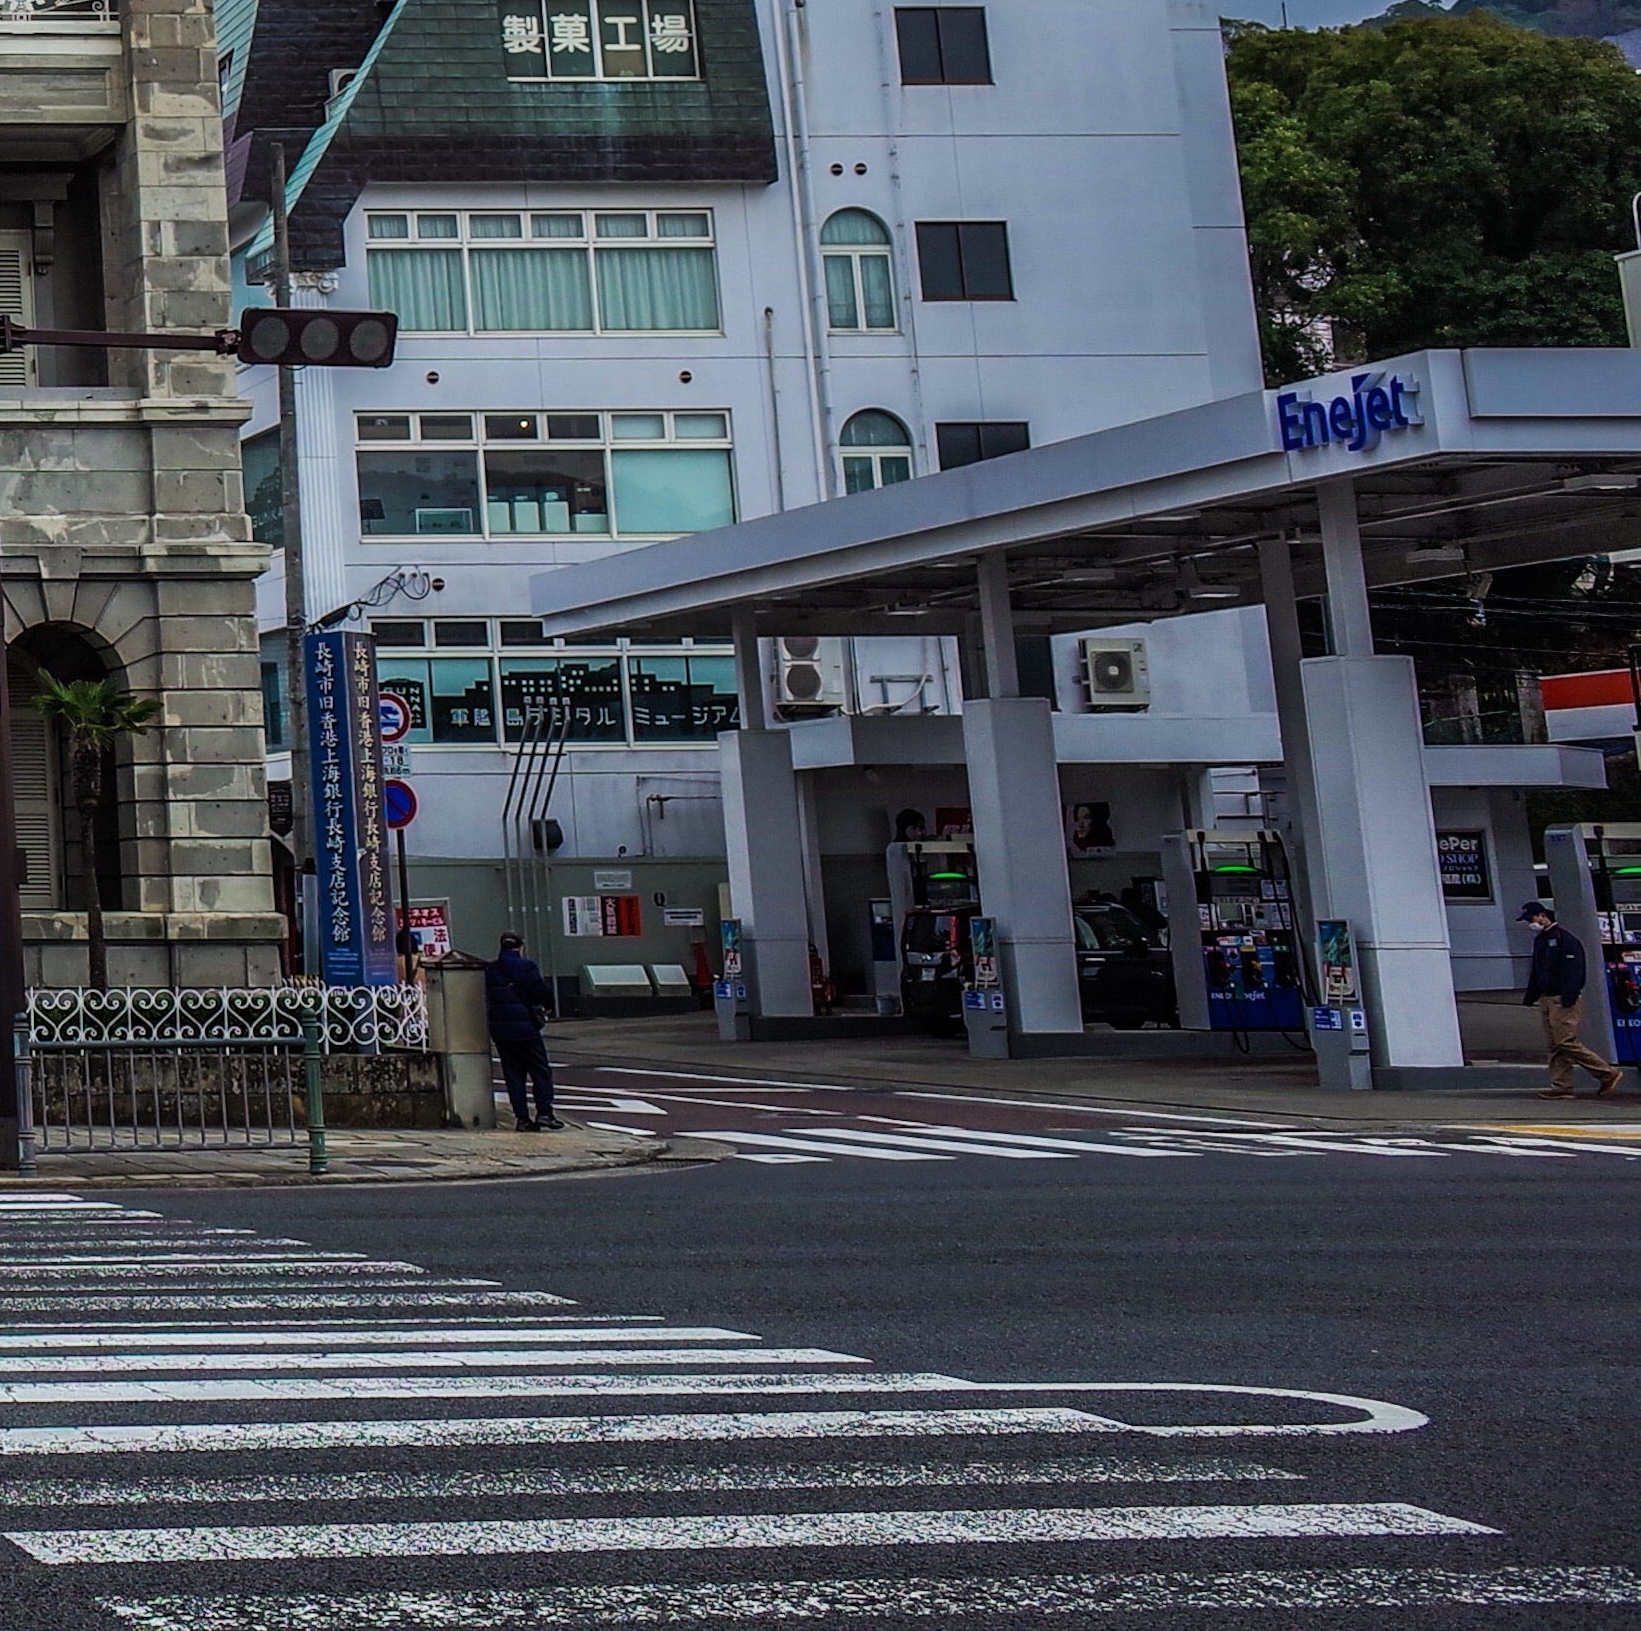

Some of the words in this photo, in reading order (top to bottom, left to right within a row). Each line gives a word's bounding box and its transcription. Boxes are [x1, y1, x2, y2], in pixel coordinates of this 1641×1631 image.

[502, 12, 689, 54] 製菓工場
[1277, 372, 1410, 453] Enejet
[314, 641, 351, 943] 長崎市旧香港上海銀行長崎支店記念館
[352, 640, 388, 943] 長崎市旧香港上海銀行長崎支店記念館
[1439, 836, 1478, 850] ePer
